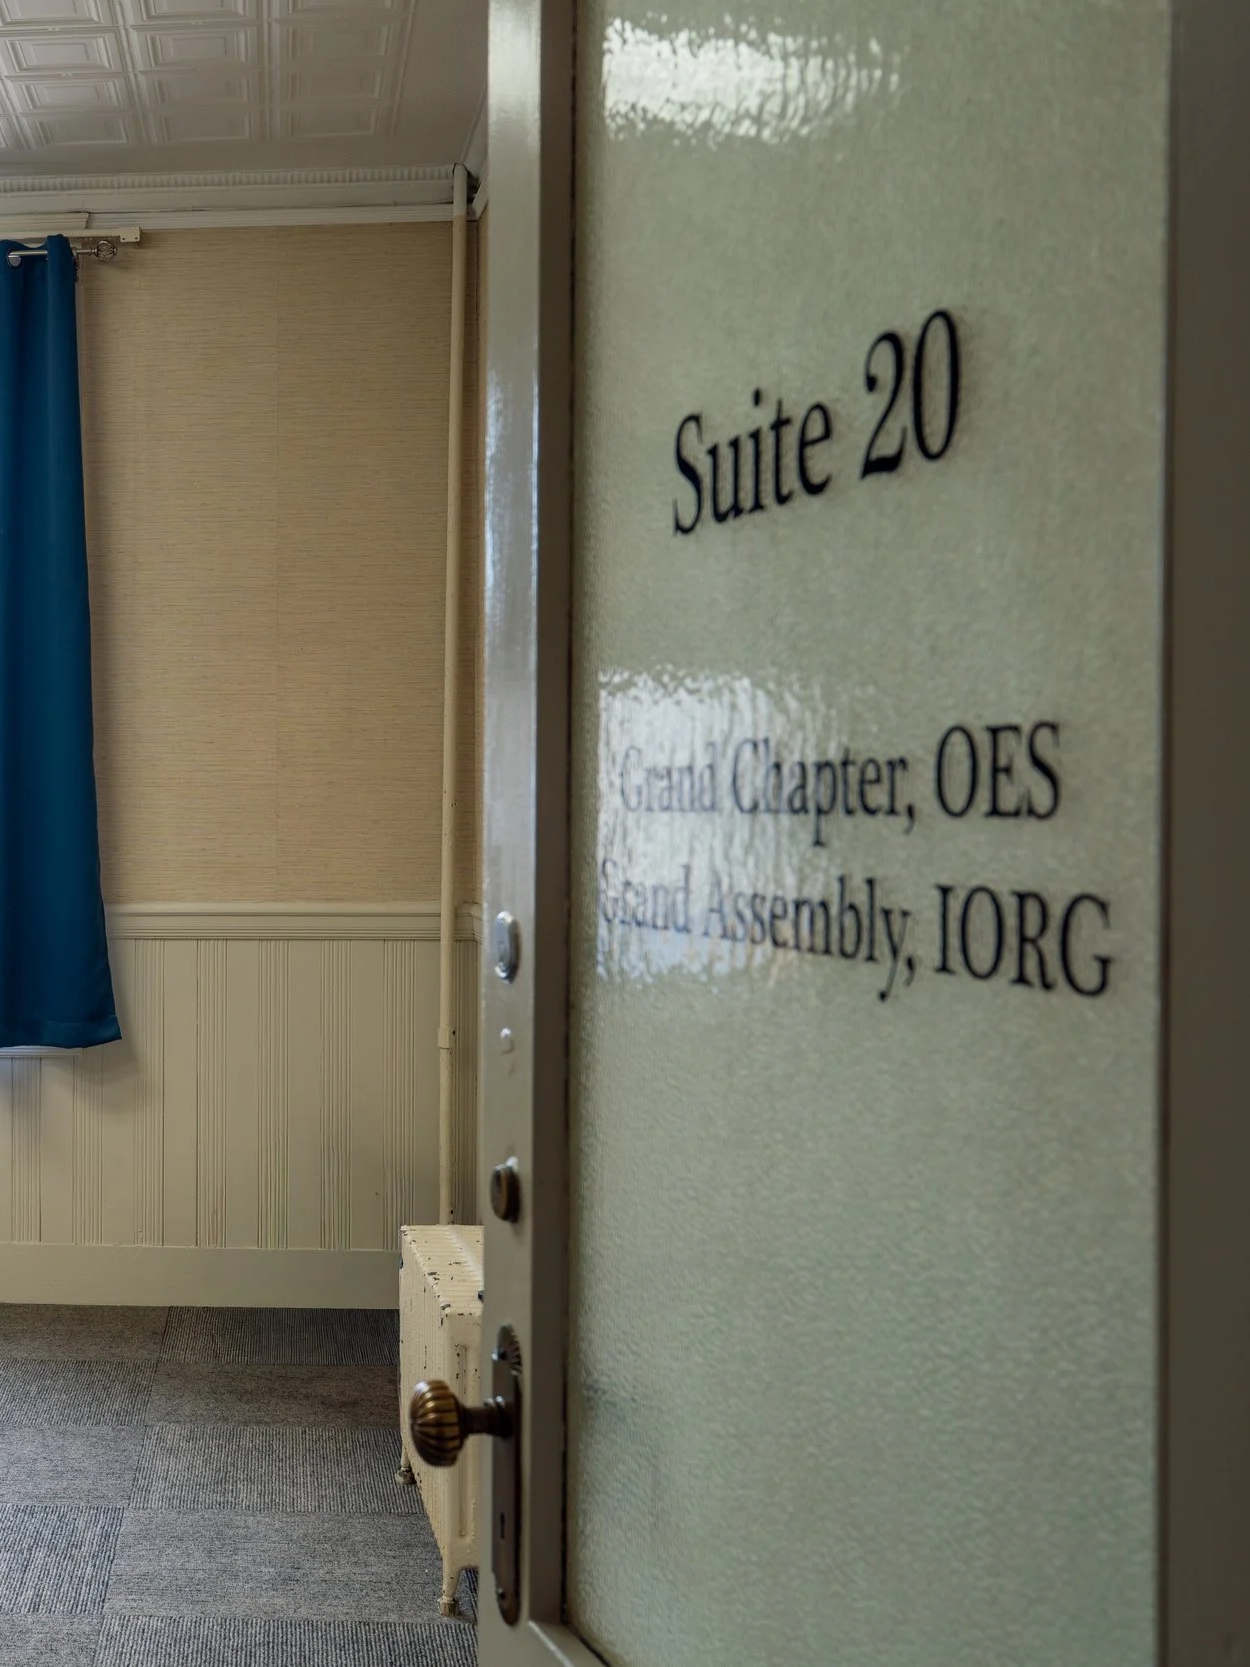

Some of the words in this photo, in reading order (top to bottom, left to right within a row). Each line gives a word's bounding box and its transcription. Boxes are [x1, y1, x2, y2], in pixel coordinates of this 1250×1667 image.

[672, 387, 834, 537] Suite
[859, 308, 962, 481] 20
[619, 740, 719, 813] Grand
[731, 736, 917, 848] Chapter,
[934, 720, 1061, 821] OES
[599, 856, 692, 935] Grand
[703, 868, 917, 1003] Assembly,
[933, 883, 1114, 999] IORG
